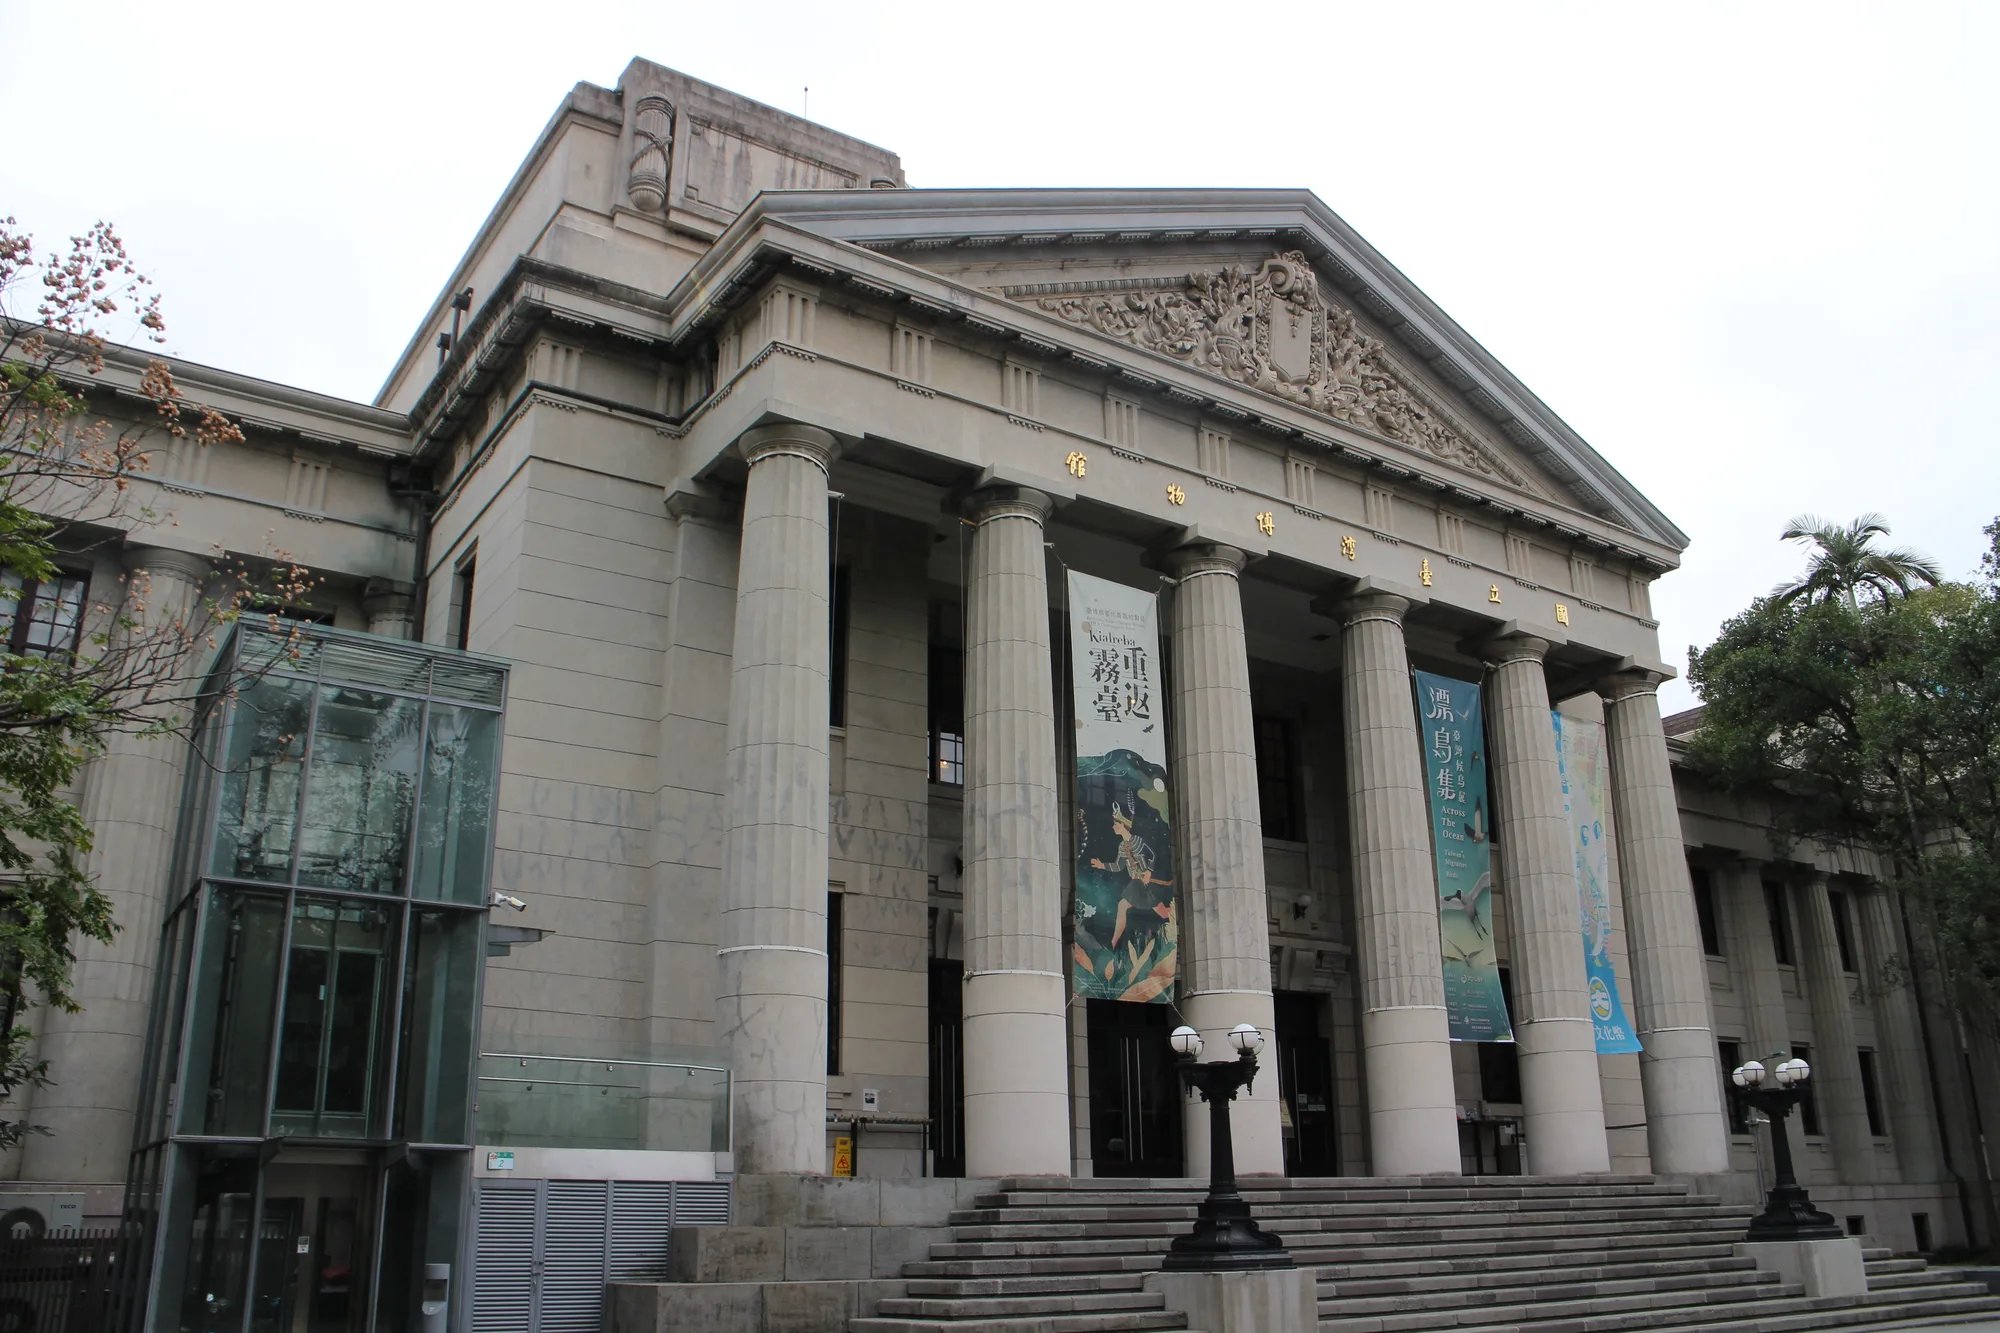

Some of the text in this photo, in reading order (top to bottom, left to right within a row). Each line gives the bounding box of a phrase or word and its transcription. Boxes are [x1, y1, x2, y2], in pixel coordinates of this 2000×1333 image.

[1440, 806, 1466, 817] Across
[1441, 817, 1456, 828] The
[1442, 829, 1465, 842] Ocean
[498, 1159, 504, 1167] 2
